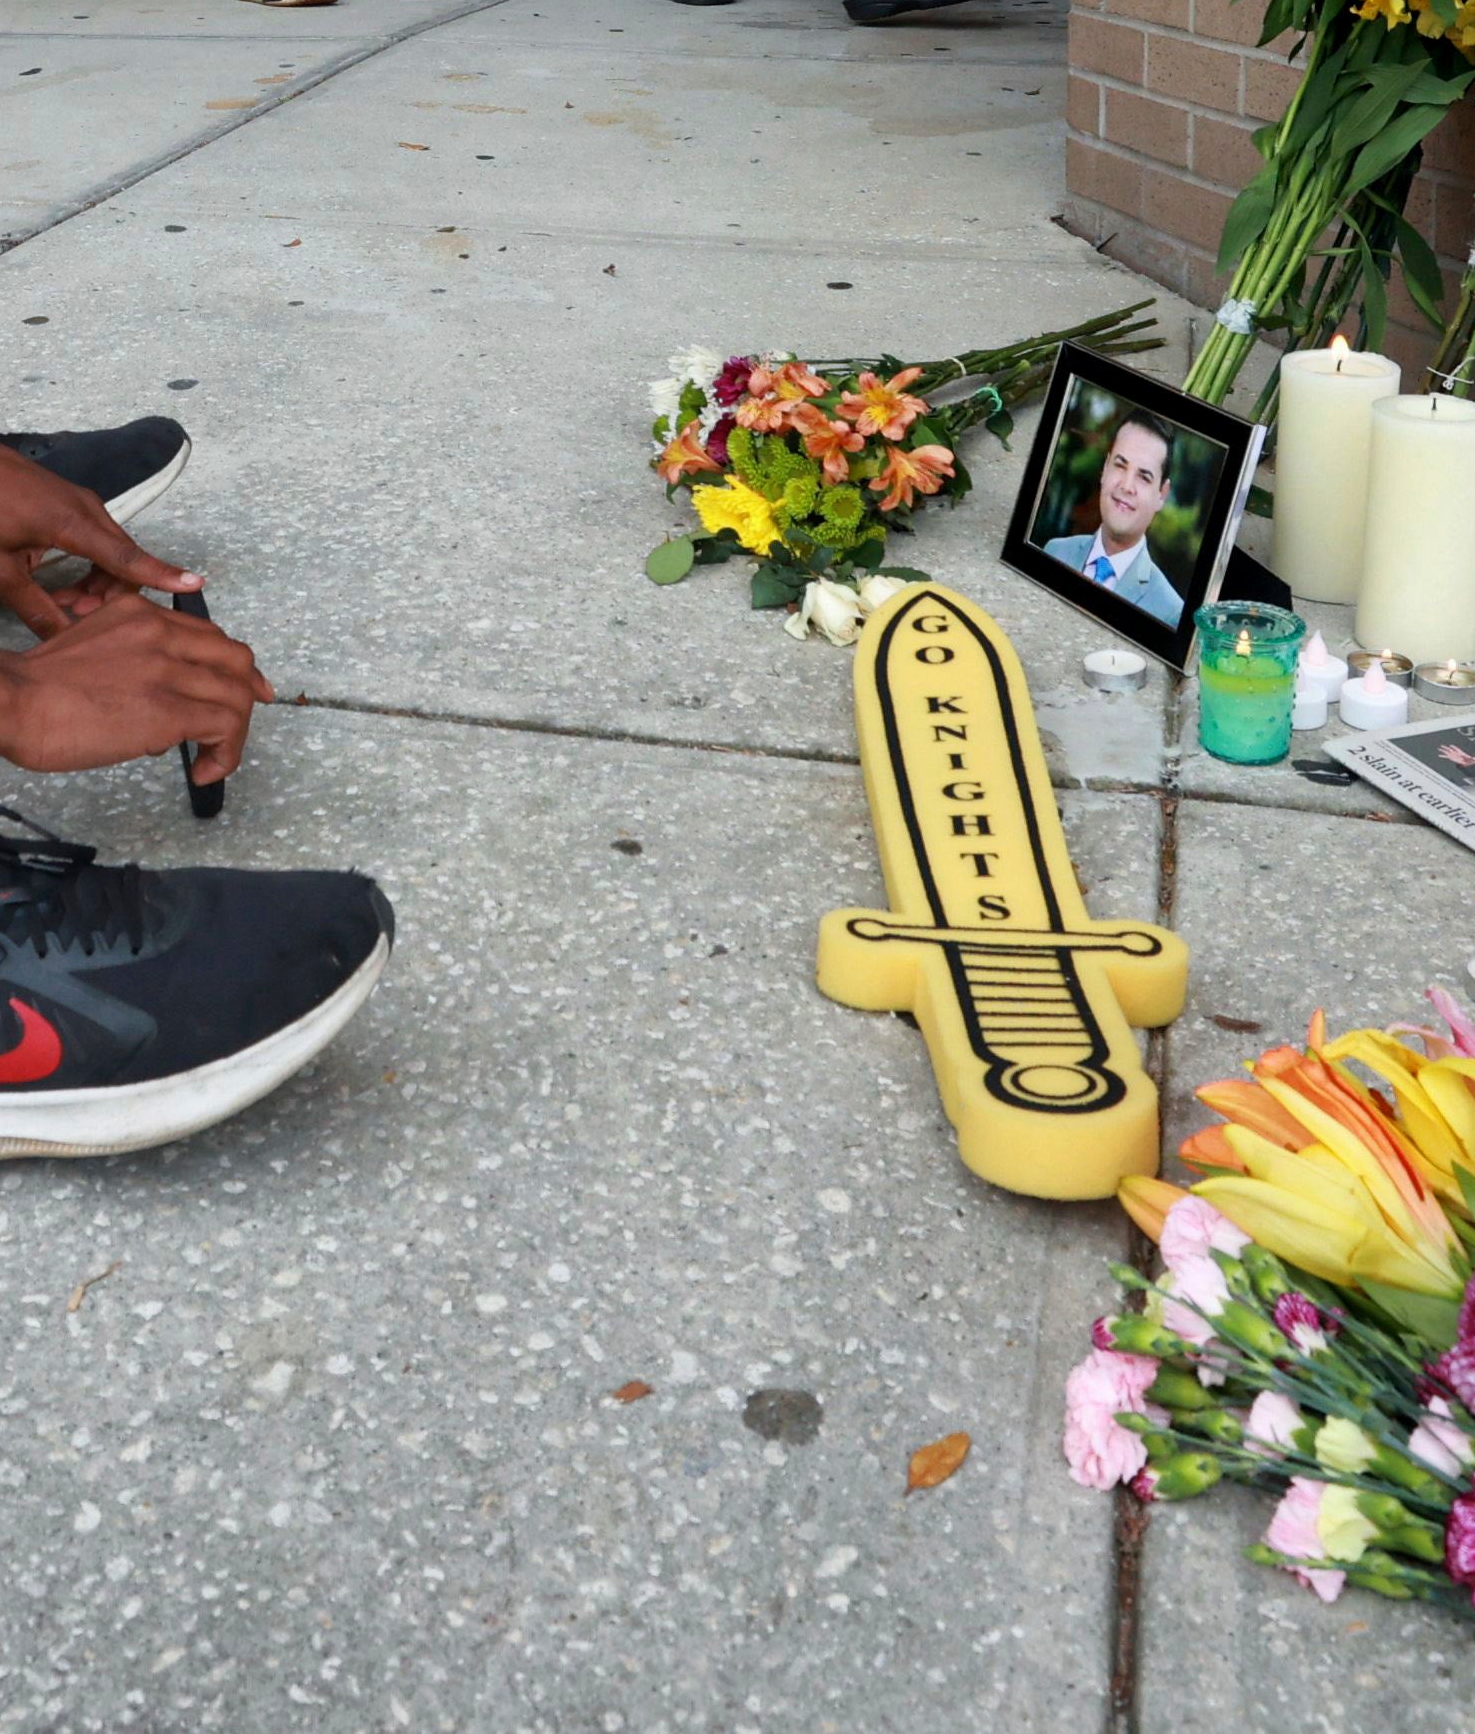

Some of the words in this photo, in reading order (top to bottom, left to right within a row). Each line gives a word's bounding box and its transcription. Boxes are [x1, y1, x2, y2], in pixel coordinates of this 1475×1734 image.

[911, 613, 956, 665] GO
[1347, 745, 1367, 756] 2
[1361, 753, 1401, 783] slain
[1398, 777, 1423, 794] at
[926, 695, 1012, 922] KNIGHTS
